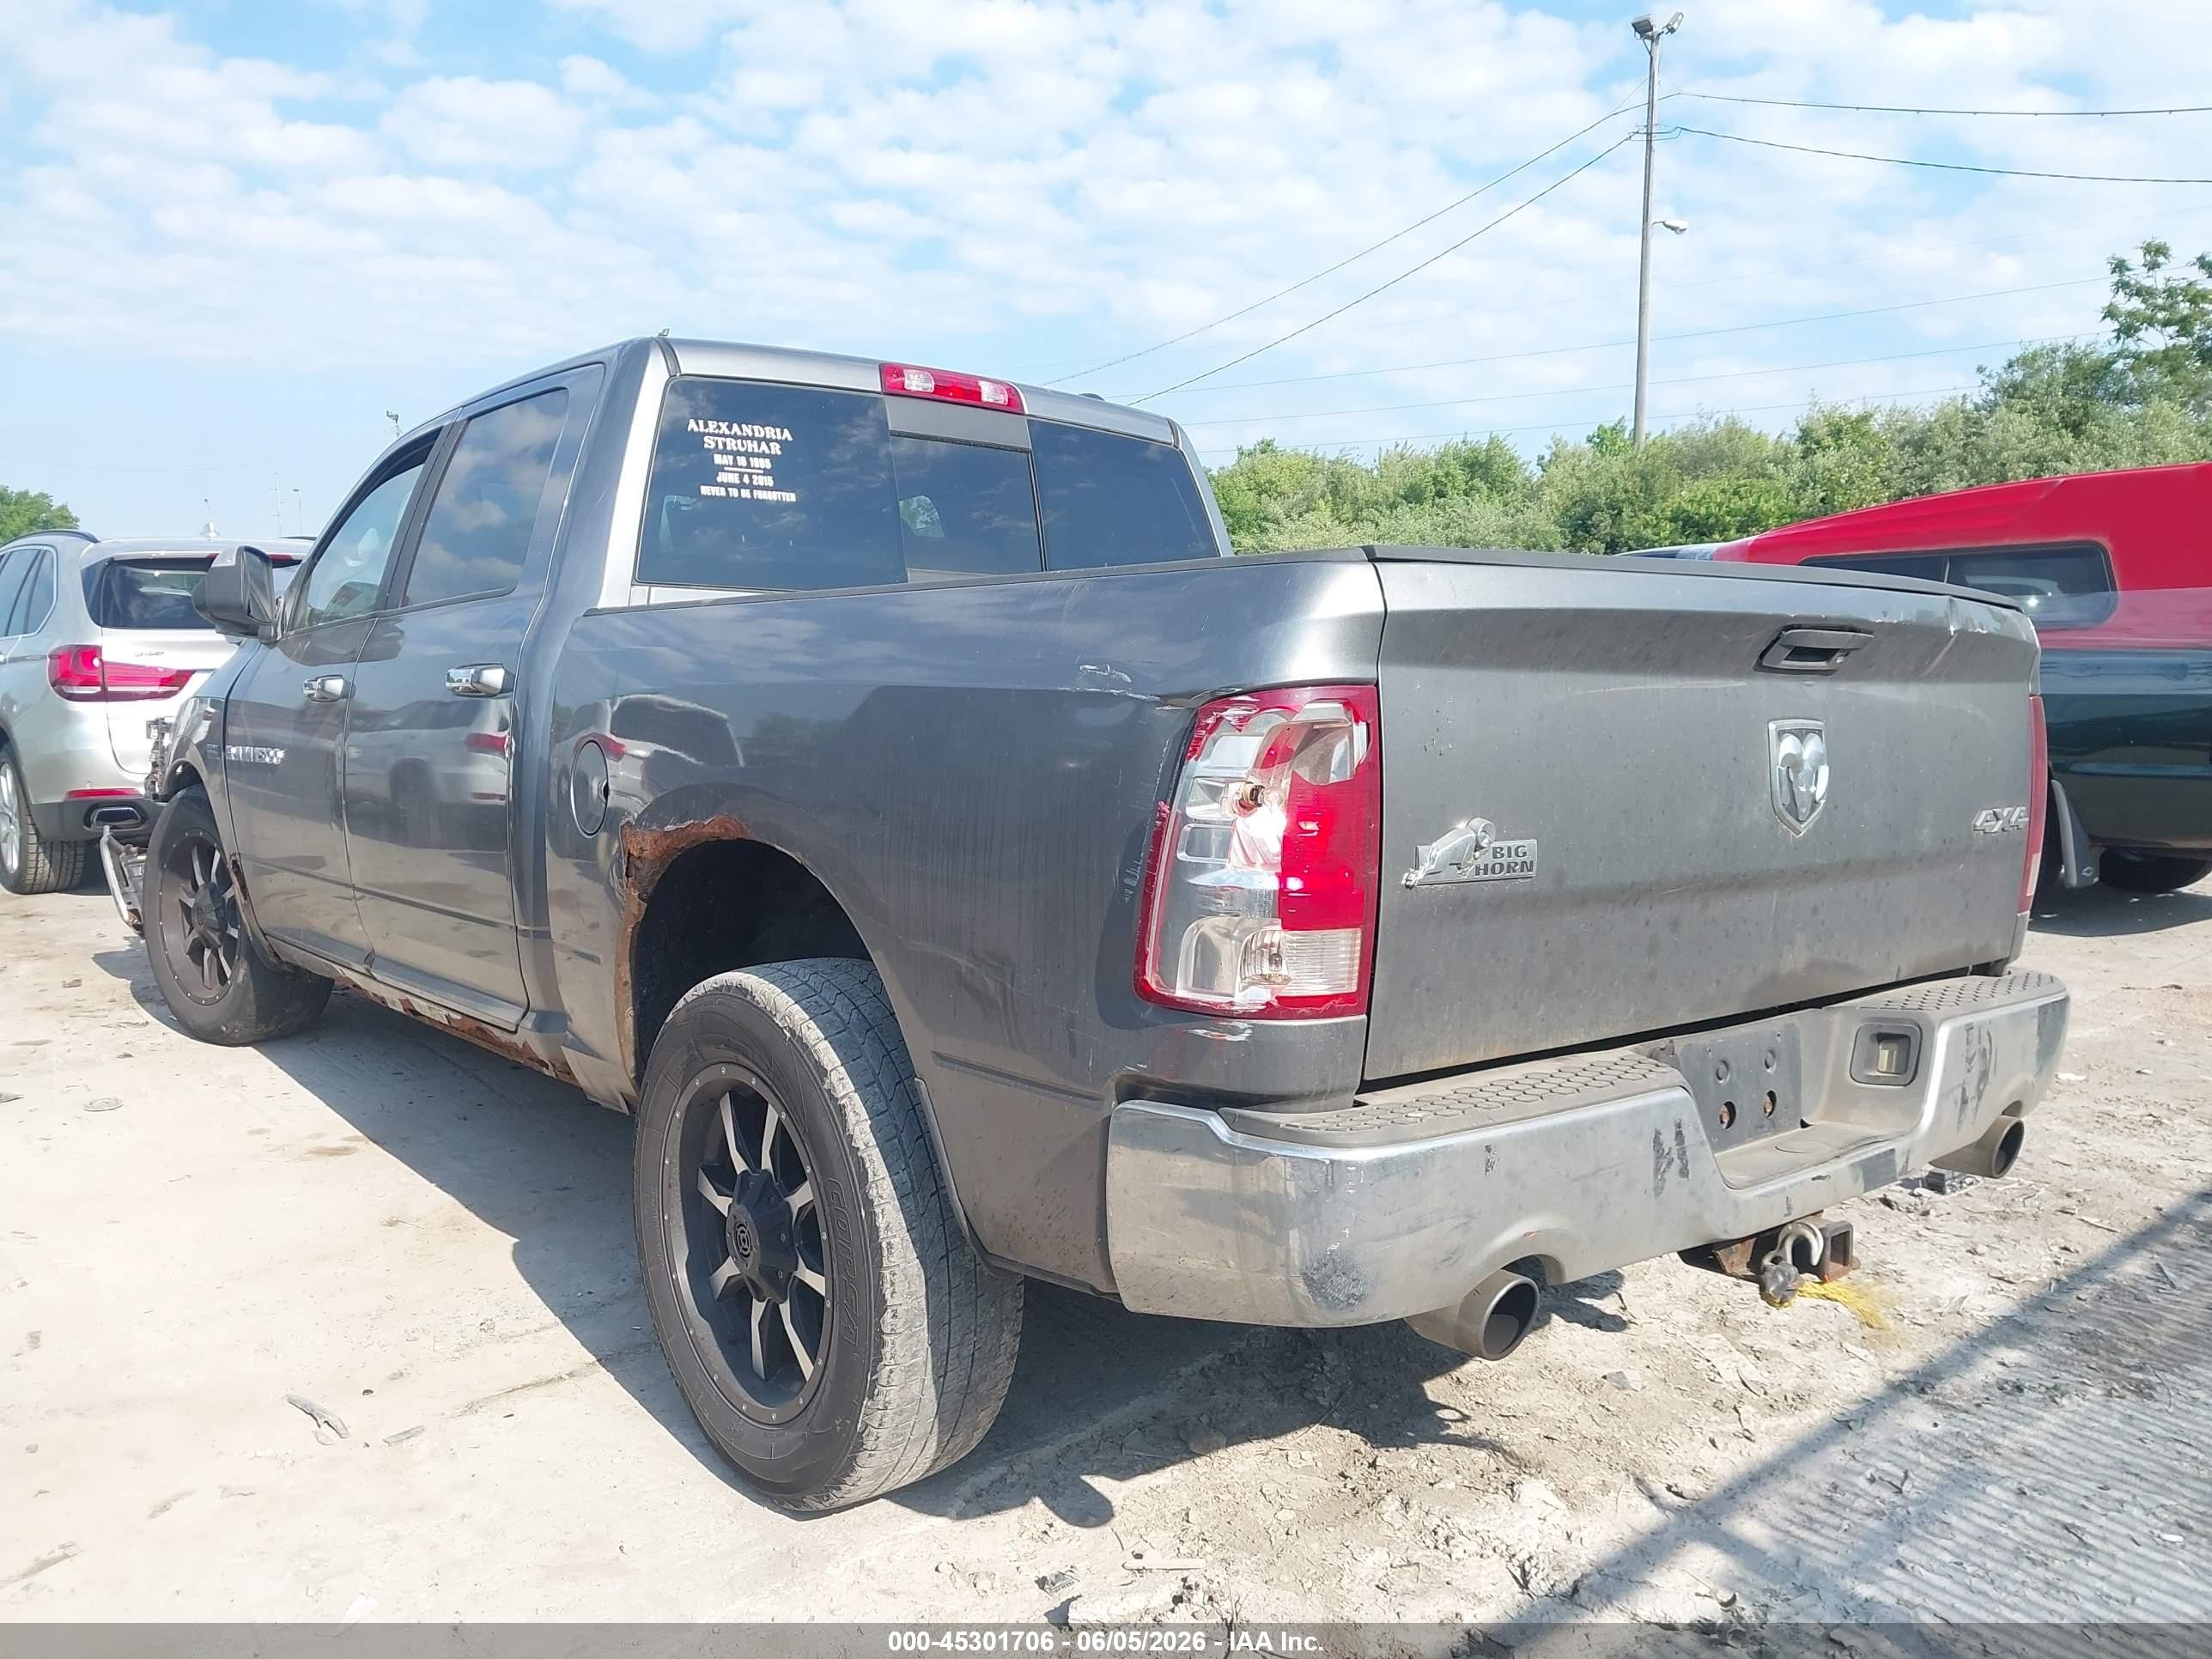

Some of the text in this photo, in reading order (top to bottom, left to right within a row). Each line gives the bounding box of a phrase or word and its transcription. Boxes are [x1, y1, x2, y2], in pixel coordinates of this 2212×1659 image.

[687, 418, 793, 441] ALEXANDRIA
[703, 435, 782, 455] STRUHAR
[714, 453, 734, 466] MAY
[716, 471, 774, 487] JUNE 4 2015
[700, 485, 797, 502] NEVER TO BE FORGOTTEN
[1492, 845, 1528, 860] BIG
[1474, 860, 1534, 877] HORN
